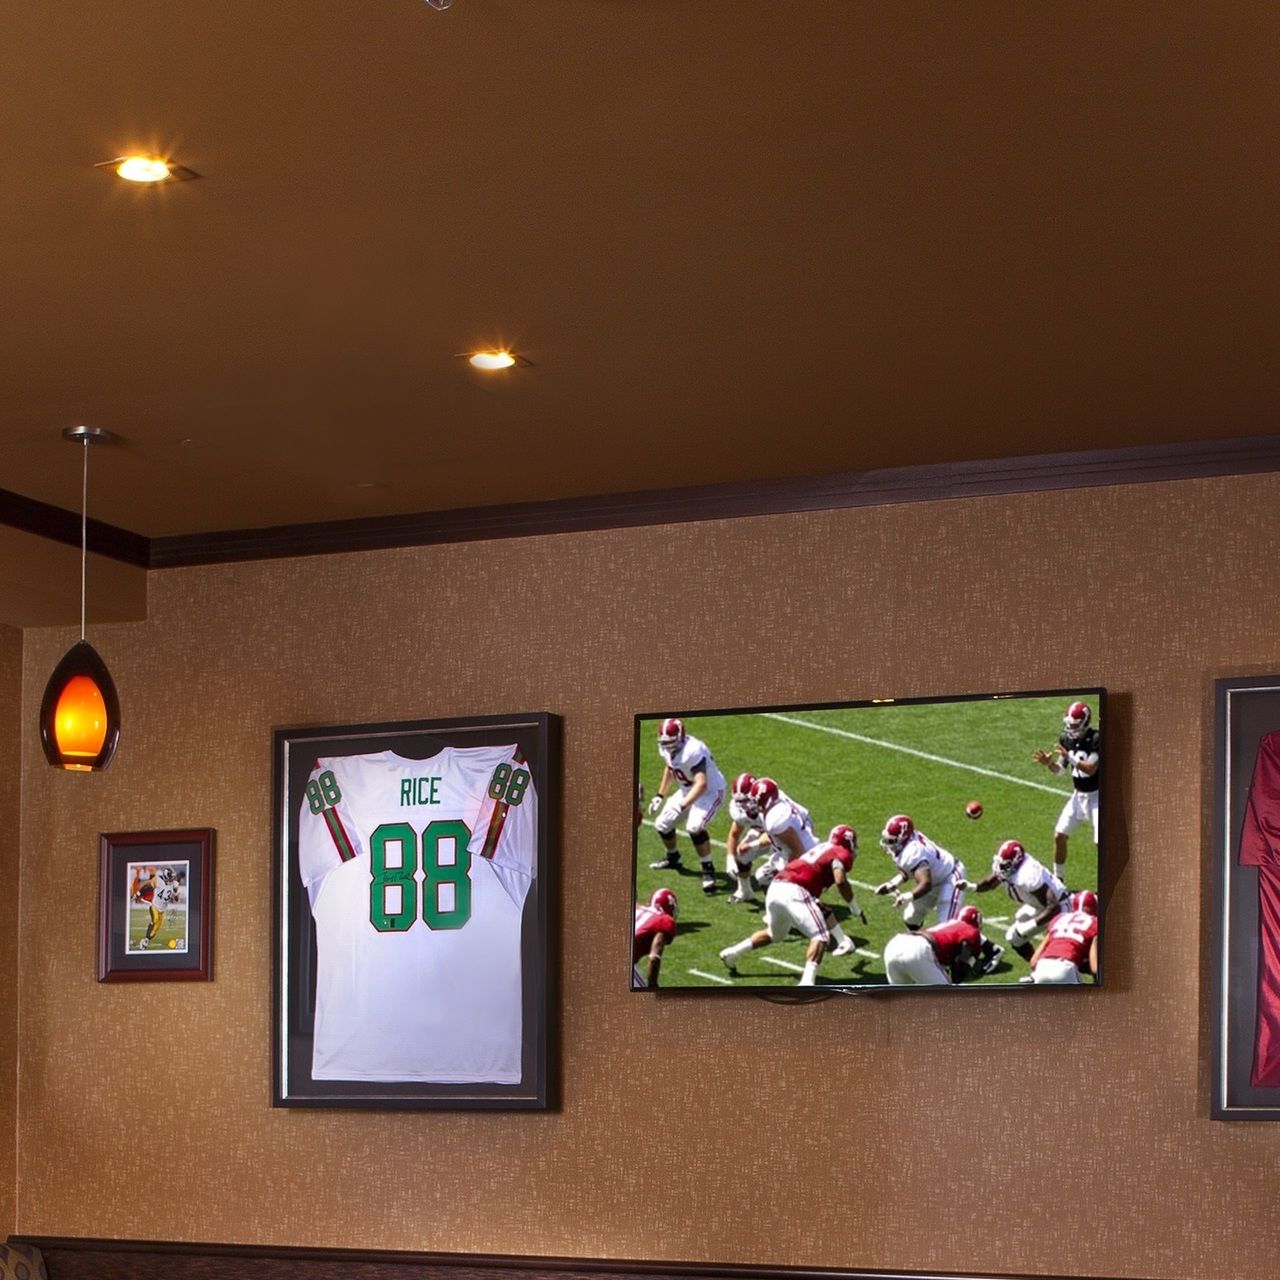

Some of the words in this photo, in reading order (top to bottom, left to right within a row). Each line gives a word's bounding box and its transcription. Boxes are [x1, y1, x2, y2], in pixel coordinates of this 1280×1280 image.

[305, 770, 342, 815] 88
[400, 777, 442, 806] RICE
[488, 763, 530, 806] 88
[370, 819, 472, 932] 88
[157, 888, 172, 901] 43
[1050, 911, 1094, 943] 42
